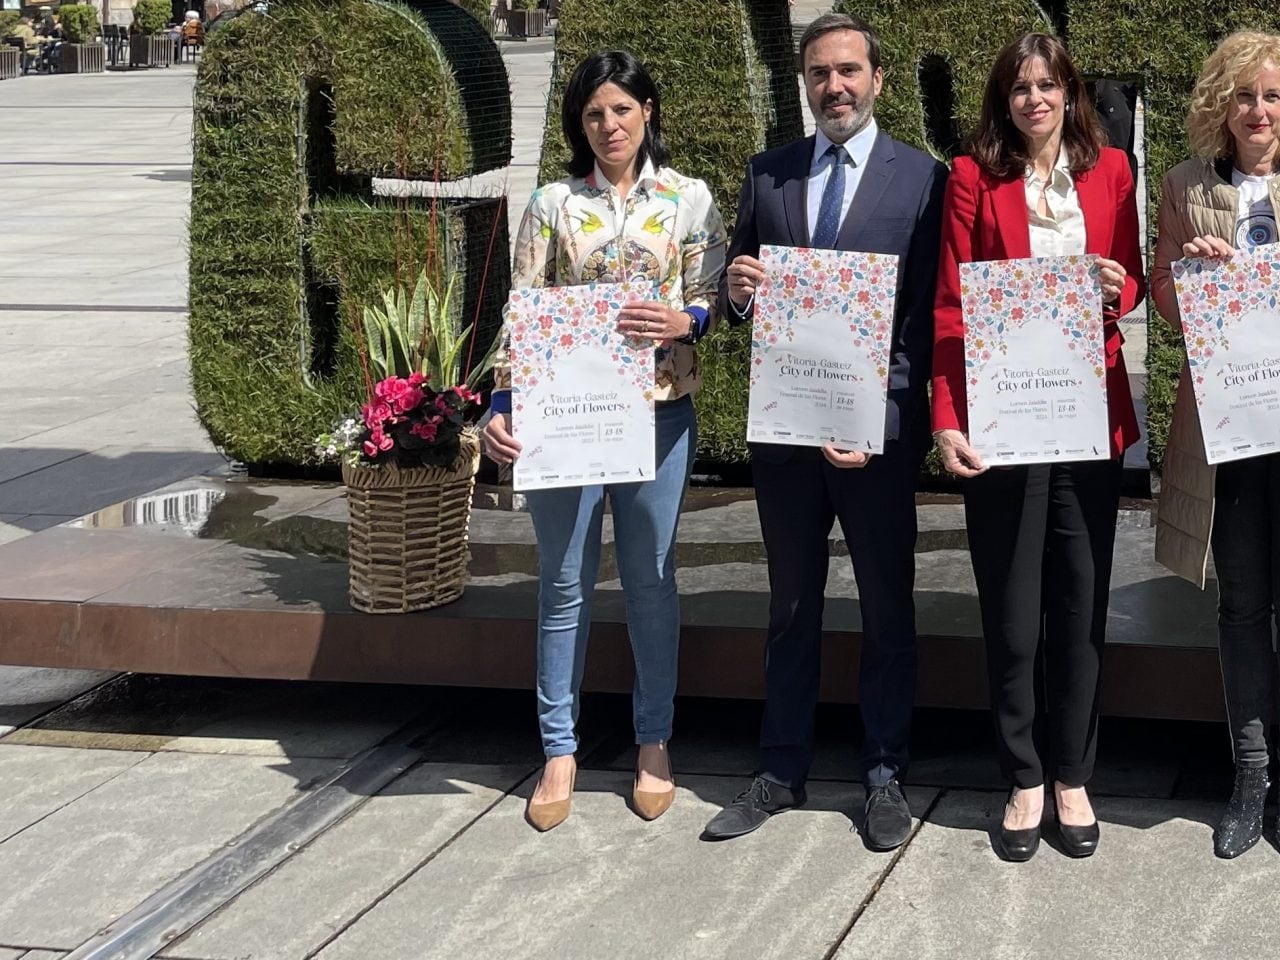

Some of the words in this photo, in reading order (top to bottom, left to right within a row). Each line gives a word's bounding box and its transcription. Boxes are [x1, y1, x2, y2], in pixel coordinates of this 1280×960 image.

[780, 365, 800, 378] City
[803, 368, 816, 377] of
[818, 369, 858, 382] Flowers
[1224, 375, 1245, 387] City
[1248, 371, 1260, 382] of
[997, 380, 1018, 392] City
[1021, 378, 1033, 389] of
[1035, 378, 1077, 389] Flowers
[544, 406, 564, 417] City
[568, 403, 580, 414] of
[583, 402, 625, 413] Flowers
